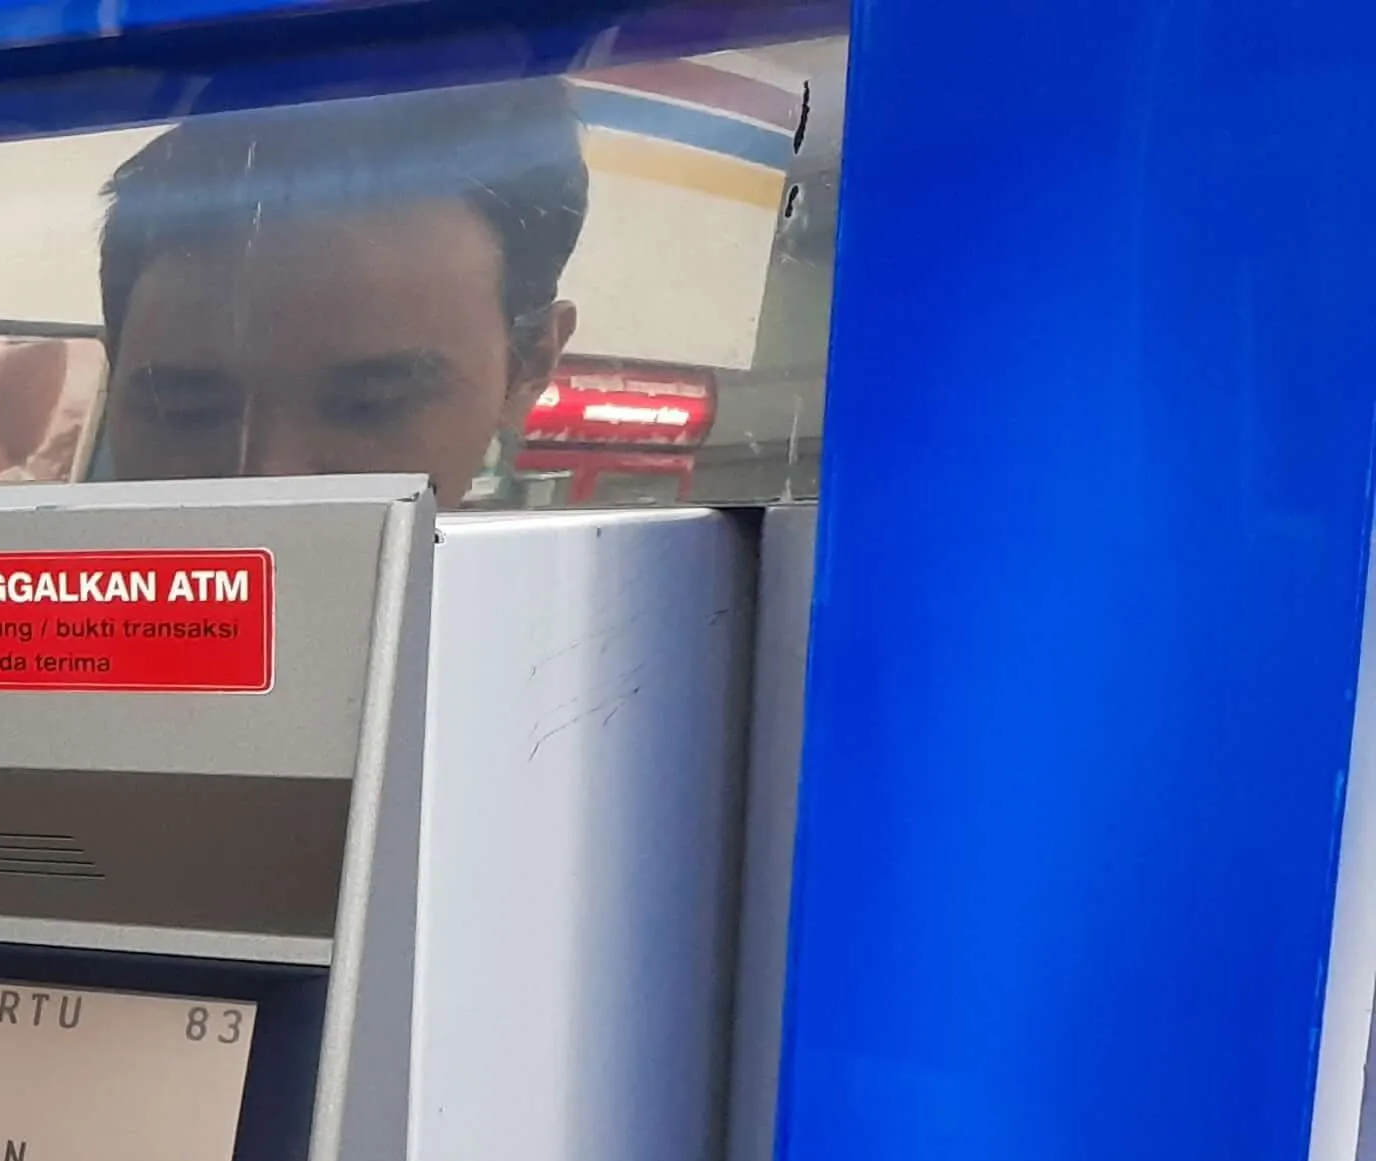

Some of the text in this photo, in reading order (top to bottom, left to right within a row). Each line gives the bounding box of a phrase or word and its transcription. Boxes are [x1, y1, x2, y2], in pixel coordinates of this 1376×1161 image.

[167, 569, 249, 602] ATM
[55, 618, 116, 639] bukti
[123, 617, 239, 639] transaksi
[35, 653, 111, 672] terima
[185, 1006, 243, 1044] 83
